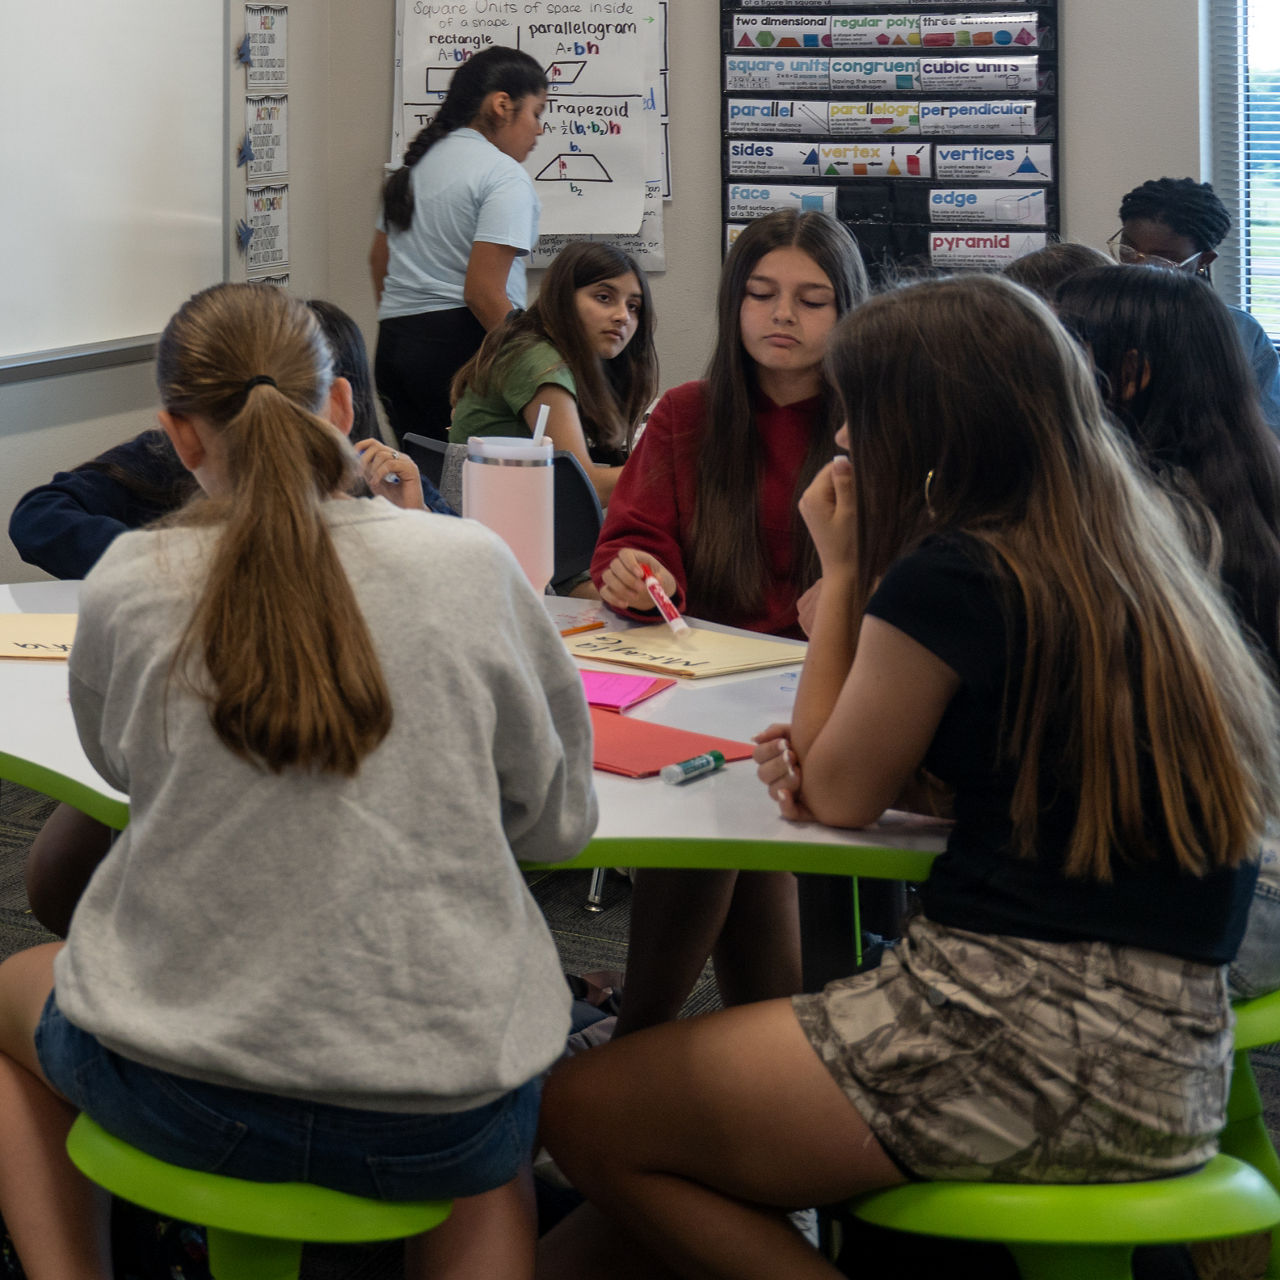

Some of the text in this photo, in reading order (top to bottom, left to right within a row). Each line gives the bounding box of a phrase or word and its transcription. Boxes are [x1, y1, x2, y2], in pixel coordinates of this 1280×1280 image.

[414, 0, 633, 16] Square Units of space inside
[736, 17, 827, 26] two dimensional
[529, 21, 637, 40] parallelogram
[429, 33, 493, 49] rectangle
[728, 60, 829, 73] square units
[923, 62, 969, 73] cubic
[547, 99, 629, 119] Trapezoid
[731, 101, 794, 119] parallel
[921, 104, 1032, 118] perpendicular
[731, 143, 774, 156] sides
[822, 146, 880, 158] vertex
[939, 147, 1015, 161] vertices
[730, 186, 770, 199] face
[932, 191, 977, 207] edge
[933, 235, 1010, 251] pyramid
